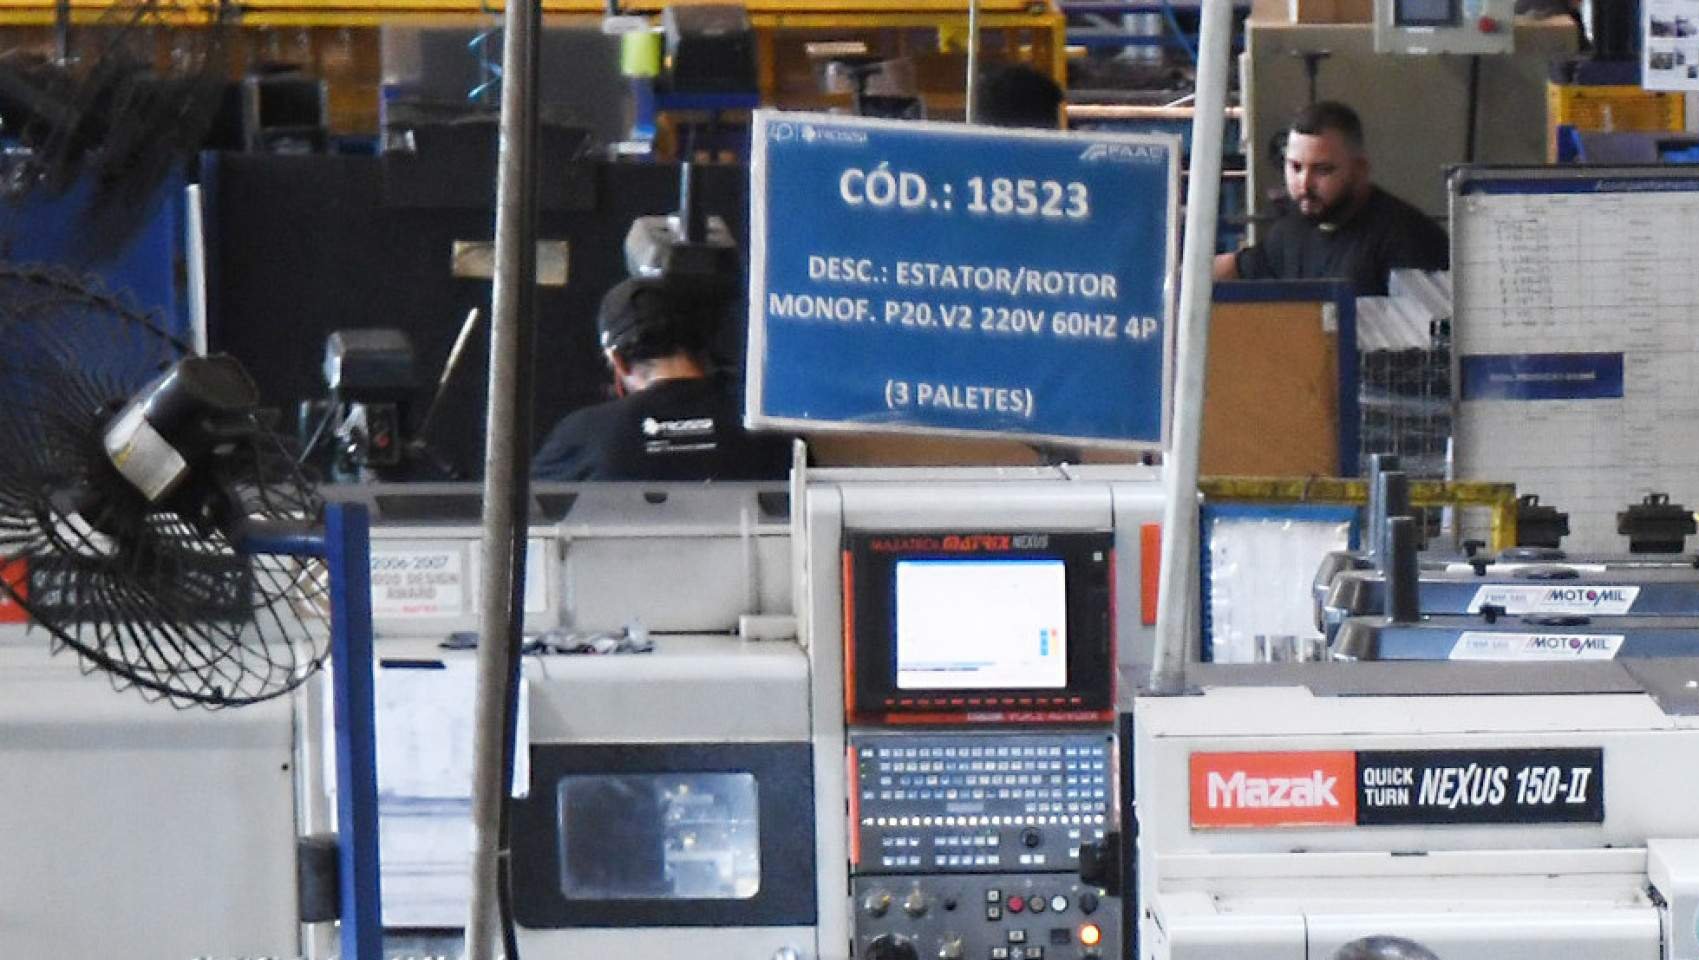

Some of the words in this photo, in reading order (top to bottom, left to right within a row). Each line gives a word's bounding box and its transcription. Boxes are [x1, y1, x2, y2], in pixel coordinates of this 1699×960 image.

[840, 161, 951, 211] CÓD.:
[967, 176, 1090, 218] 18523
[809, 255, 887, 283] DESC.:
[896, 261, 1117, 298] ESTATOR/ROTOR
[769, 292, 877, 323] MONOF.
[885, 300, 973, 330] P20.V2
[981, 306, 1044, 332] 220V
[1052, 311, 1117, 338] 60HZ
[1125, 315, 1157, 339] 4P
[885, 379, 908, 409] (3
[917, 382, 1033, 417] PALETES)
[1207, 769, 1338, 809] Mazak
[1364, 767, 1414, 786] QUICK
[1365, 787, 1409, 806] TURN
[1418, 763, 1507, 809] NEXUS
[1517, 766, 1592, 805] 150-II
